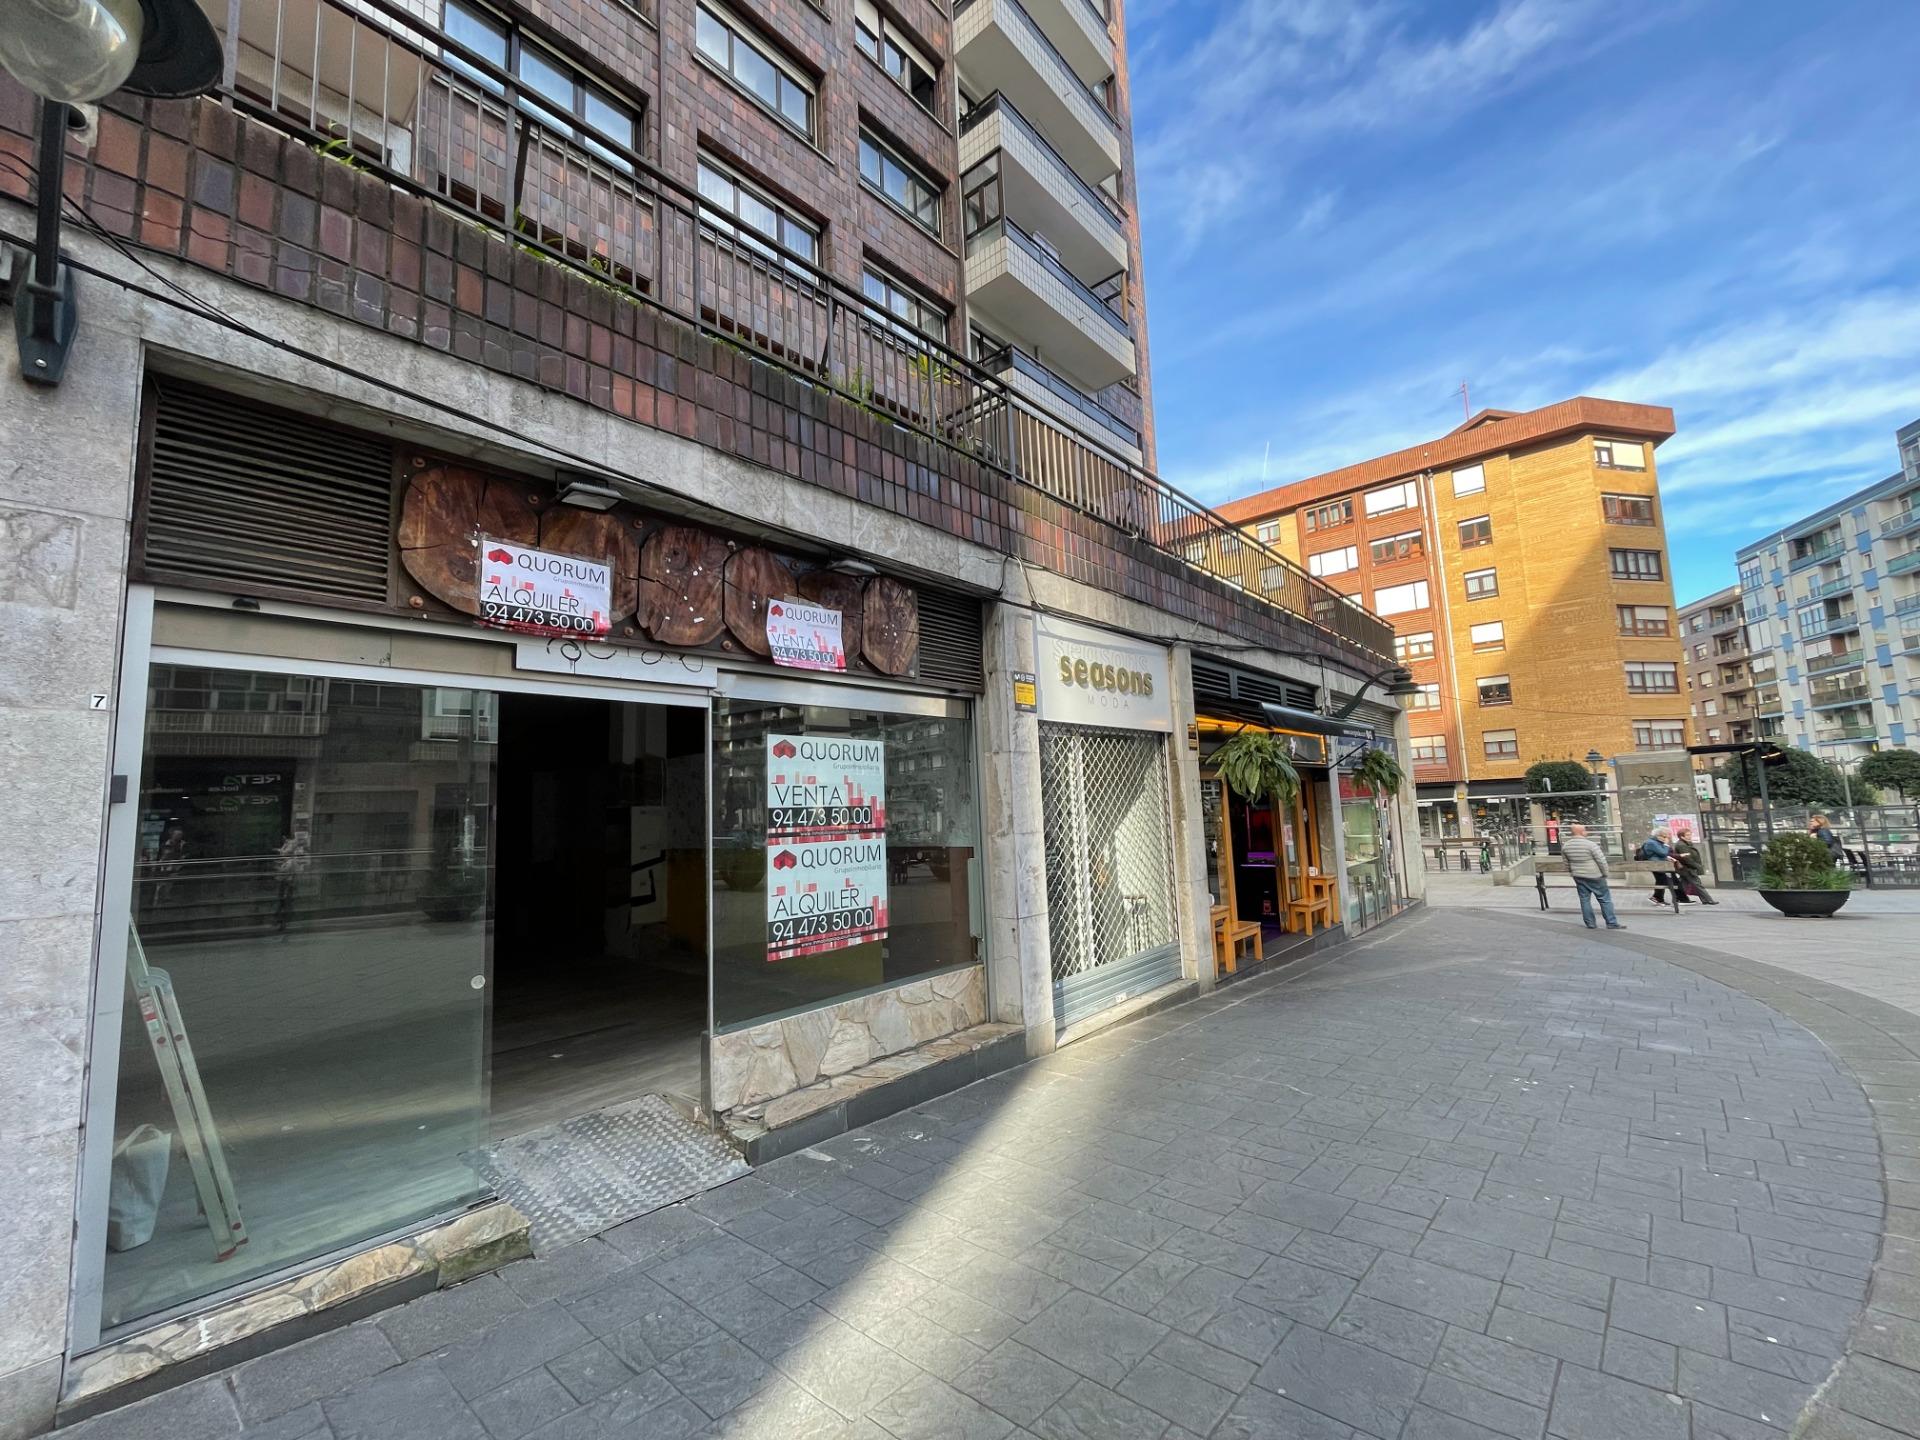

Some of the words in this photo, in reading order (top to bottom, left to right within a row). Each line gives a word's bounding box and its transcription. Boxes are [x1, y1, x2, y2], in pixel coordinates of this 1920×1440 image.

[518, 554, 605, 584] QUORUM
[487, 585, 579, 614] ALQUILER
[486, 603, 508, 619] 94
[512, 608, 545, 625] 473
[549, 613, 570, 628] 50
[574, 617, 594, 632] 00
[785, 607, 838, 626] QUORUM
[771, 633, 815, 650] VENTA
[773, 647, 786, 657] 94
[788, 648, 807, 660] 473
[809, 651, 820, 662] 50
[822, 652, 835, 664] 00
[1059, 655, 1154, 697] seasons
[93, 695, 105, 708] 7
[1088, 695, 1130, 710] MODA
[800, 741, 879, 762] QUORUM
[775, 785, 843, 806] VENTA
[772, 809, 794, 828] 94
[797, 807, 826, 826] 473
[830, 807, 850, 826] 50
[853, 807, 871, 825] 00
[801, 844, 881, 869] QUORUM
[774, 888, 859, 919] ALQUILER
[773, 920, 794, 942] 94
[798, 915, 828, 936] 473
[832, 911, 851, 931] 50
[855, 908, 873, 927] 00
